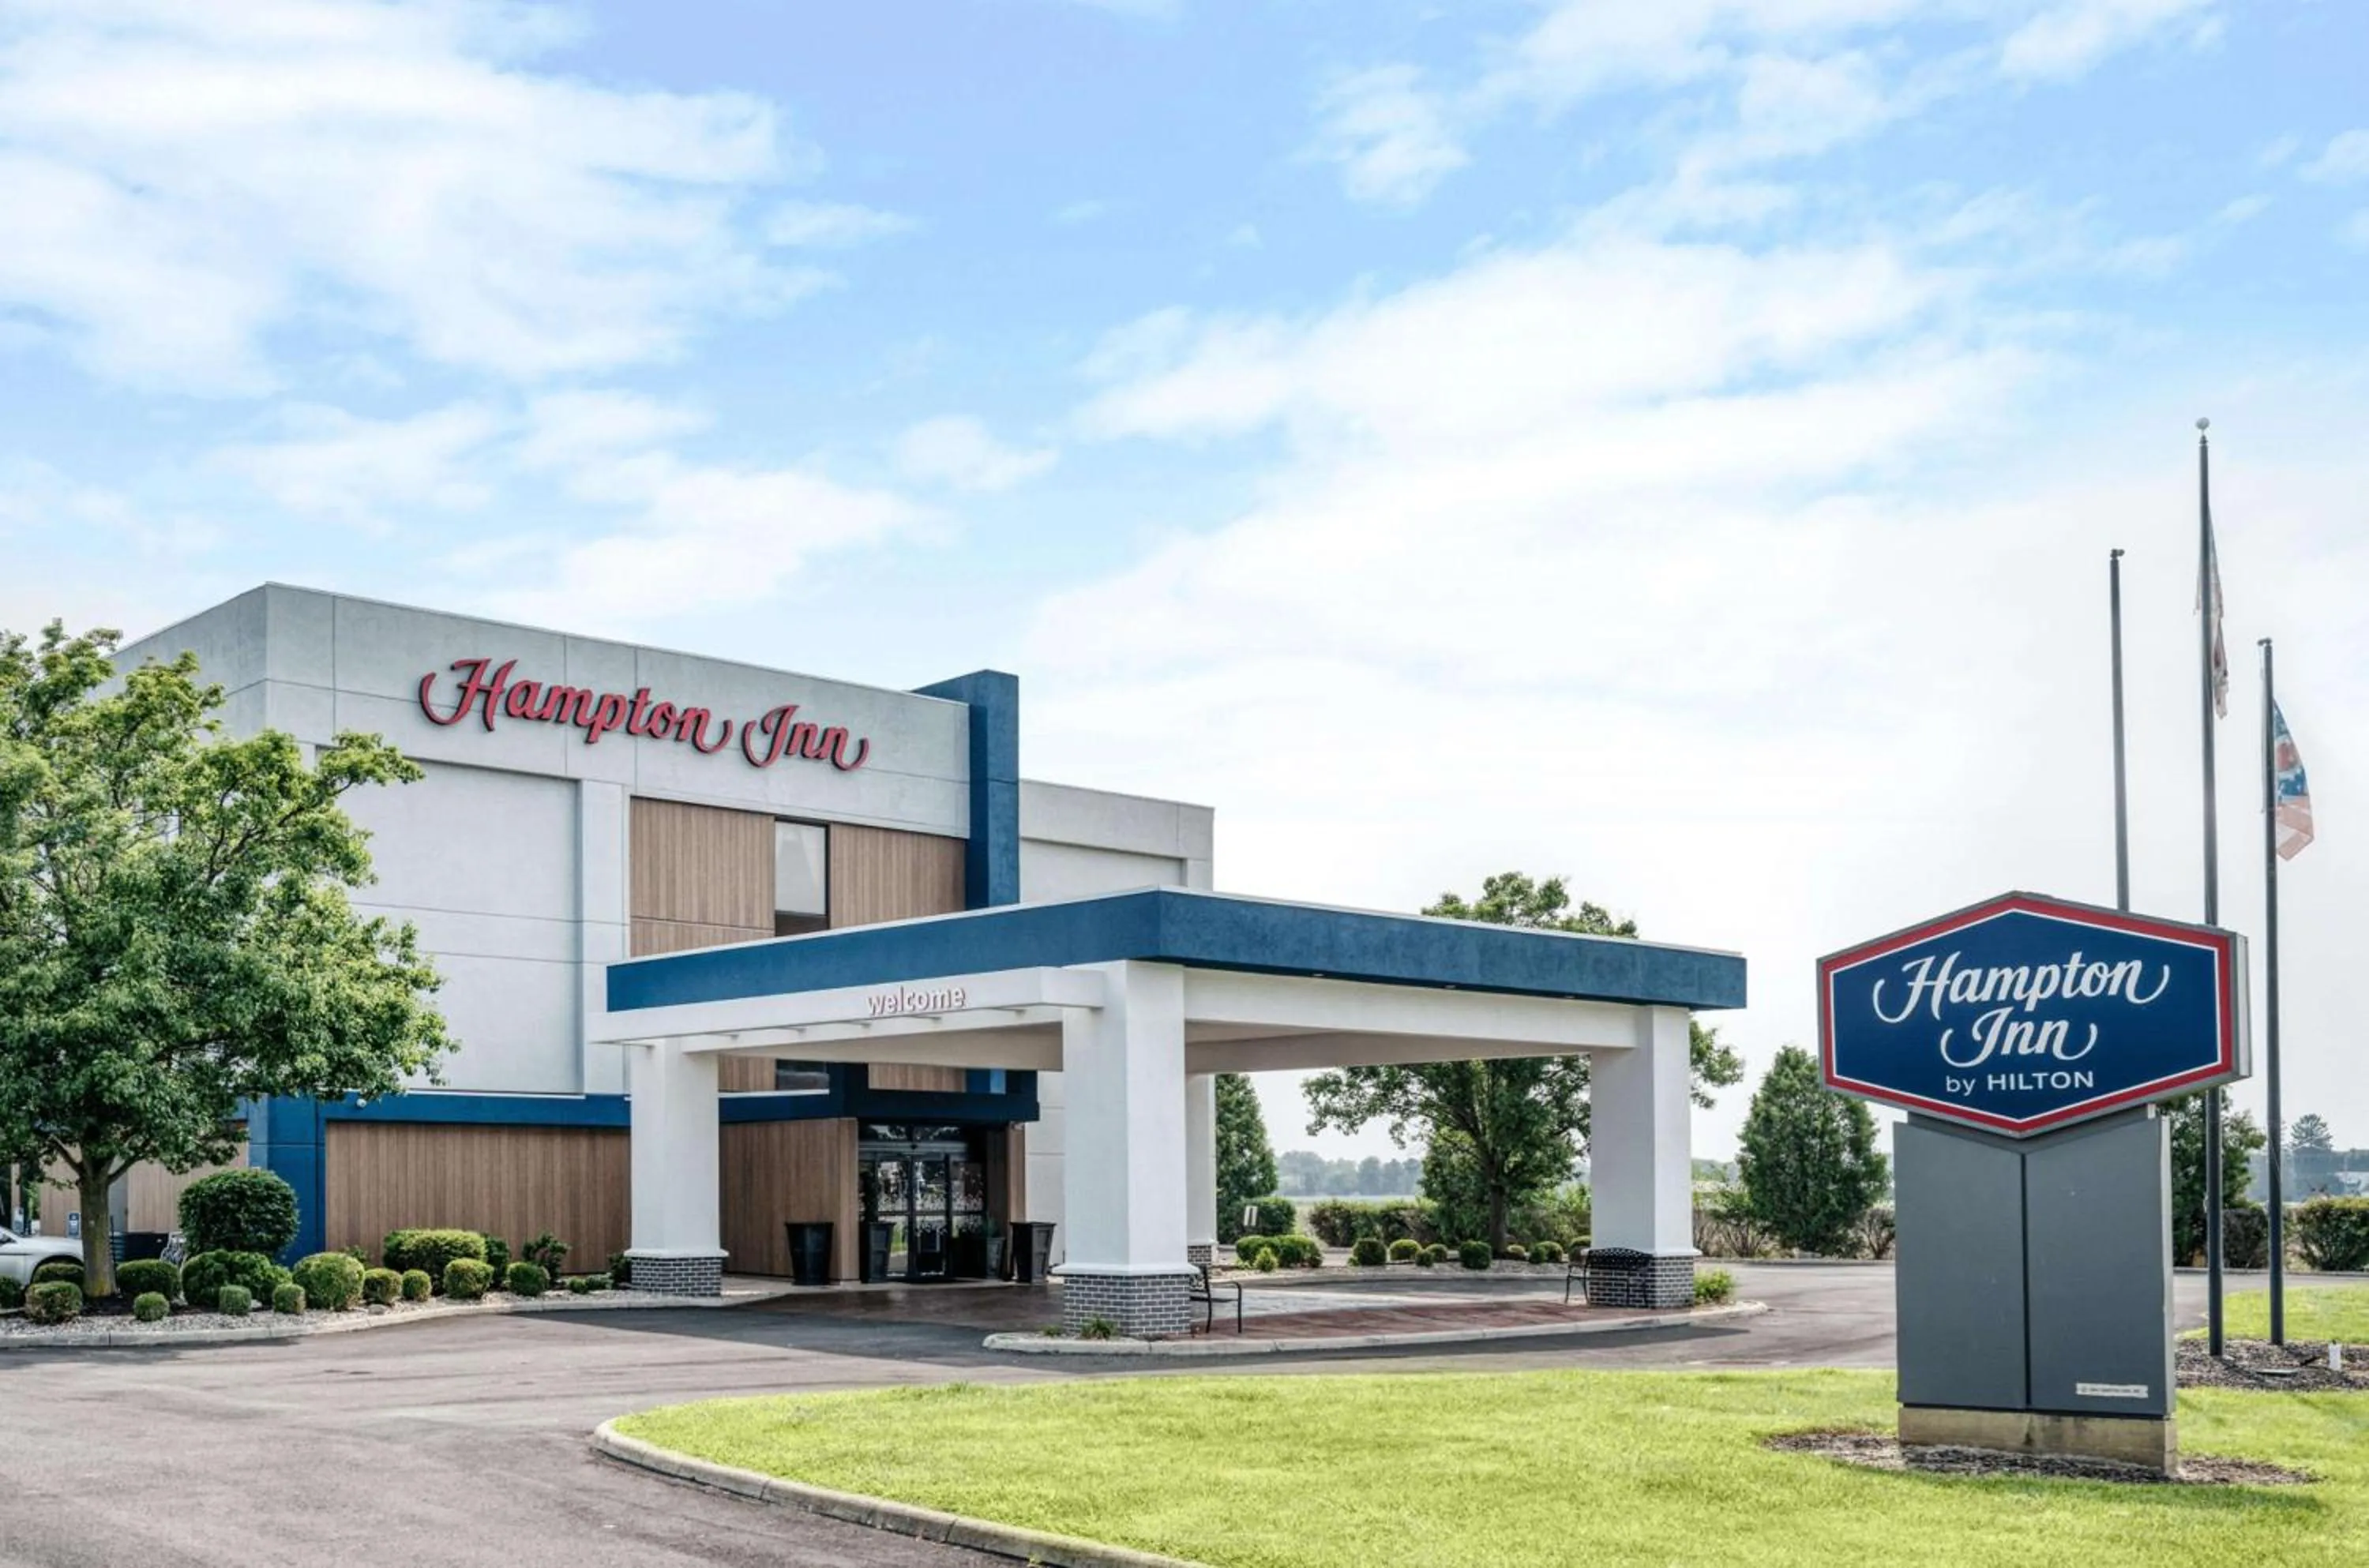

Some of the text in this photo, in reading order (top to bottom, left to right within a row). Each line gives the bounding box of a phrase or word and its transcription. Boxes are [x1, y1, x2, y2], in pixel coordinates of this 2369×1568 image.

[419, 658, 869, 771] Hampton Inn
[866, 985, 966, 1015] welcome
[1873, 951, 2170, 1023] Hampton
[1940, 1007, 2098, 1067] Inn
[1946, 1071, 2095, 1097] by HILTON
